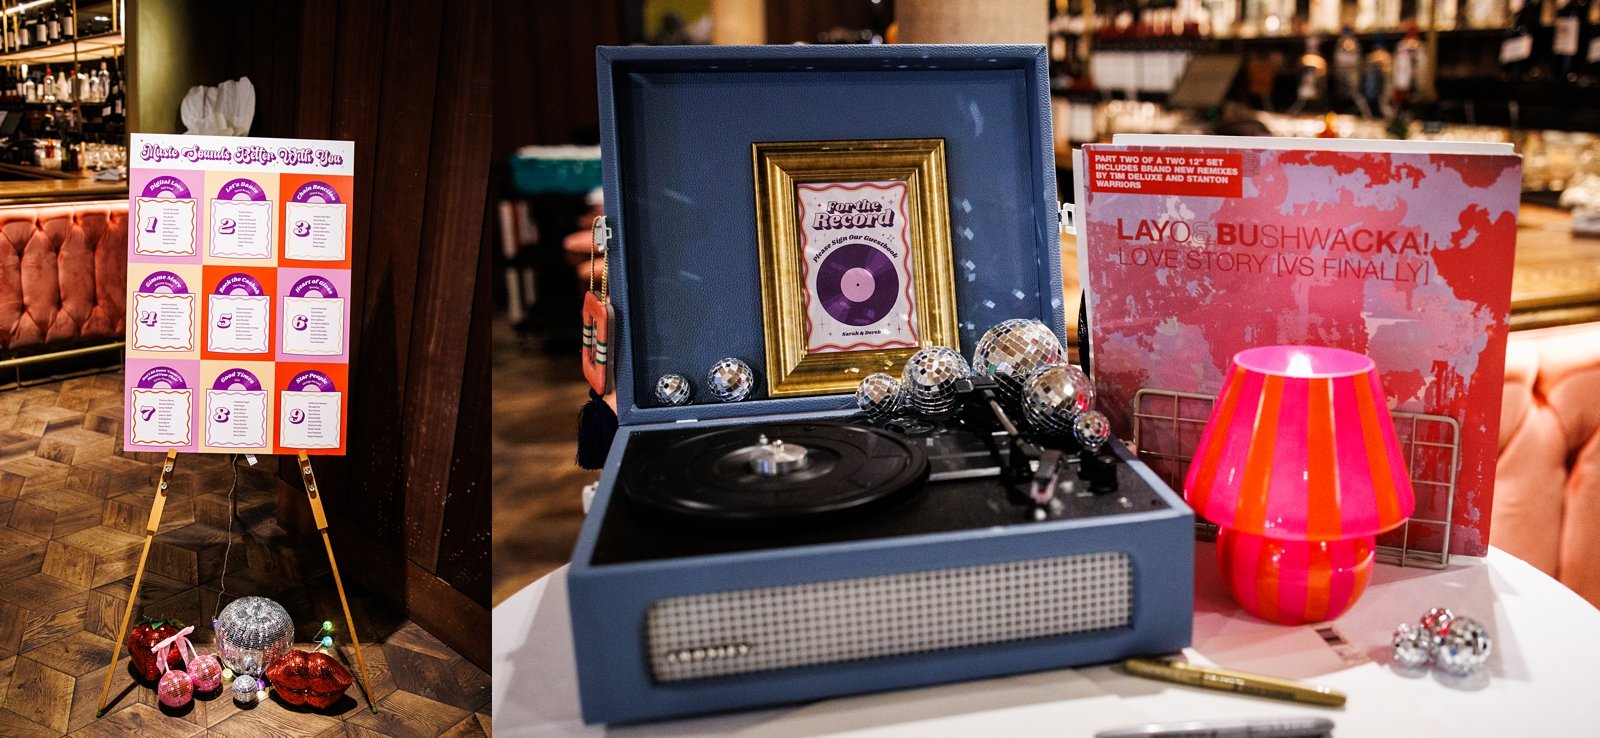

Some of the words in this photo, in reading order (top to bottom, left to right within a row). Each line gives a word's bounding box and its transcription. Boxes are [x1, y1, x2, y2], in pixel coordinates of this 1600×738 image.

[140, 143, 180, 162] Music
[182, 144, 232, 162] Sounds
[234, 145, 276, 166] Better
[278, 146, 314, 166] With
[315, 148, 344, 166] You
[1095, 164, 1138, 172] INCLUDES
[1197, 167, 1238, 176] REMIXES
[150, 179, 171, 190] Digital
[171, 180, 184, 192] Love
[226, 182, 240, 192] Let's
[241, 182, 258, 193] Dance
[1096, 180, 1141, 189] WARRIORS
[1187, 176, 1229, 184] STANTON
[297, 185, 312, 200] Chain
[313, 185, 336, 201] Reaction
[826, 200, 854, 214] For
[852, 199, 882, 212] the
[145, 216, 158, 233] 1
[218, 218, 237, 235] 2
[812, 208, 895, 230] Record
[293, 220, 311, 237] 3
[1116, 218, 1191, 244] LAYO
[1217, 222, 1429, 255] BUSHWACKA!
[813, 243, 832, 263] Please
[832, 236, 848, 246] Sign
[864, 235, 898, 259] Guestbook
[1118, 246, 1178, 268] LOVE
[1186, 252, 1267, 274] STORY
[1277, 253, 1314, 278] [VS
[1324, 258, 1429, 285] FINALLY]
[146, 275, 166, 288] Gimme
[167, 276, 182, 288] More
[219, 280, 231, 294] Rock
[242, 278, 260, 294] Casbah
[295, 279, 311, 293] Heart
[318, 280, 333, 295] Glass
[140, 310, 158, 327] 4
[217, 313, 232, 329] 5
[292, 314, 308, 331] 6
[221, 372, 236, 383] Good
[237, 372, 254, 384] Times
[296, 373, 308, 384] Star
[309, 373, 328, 384] People
[140, 405, 156, 421] 7
[213, 406, 230, 423] 8
[288, 408, 305, 424] 9
